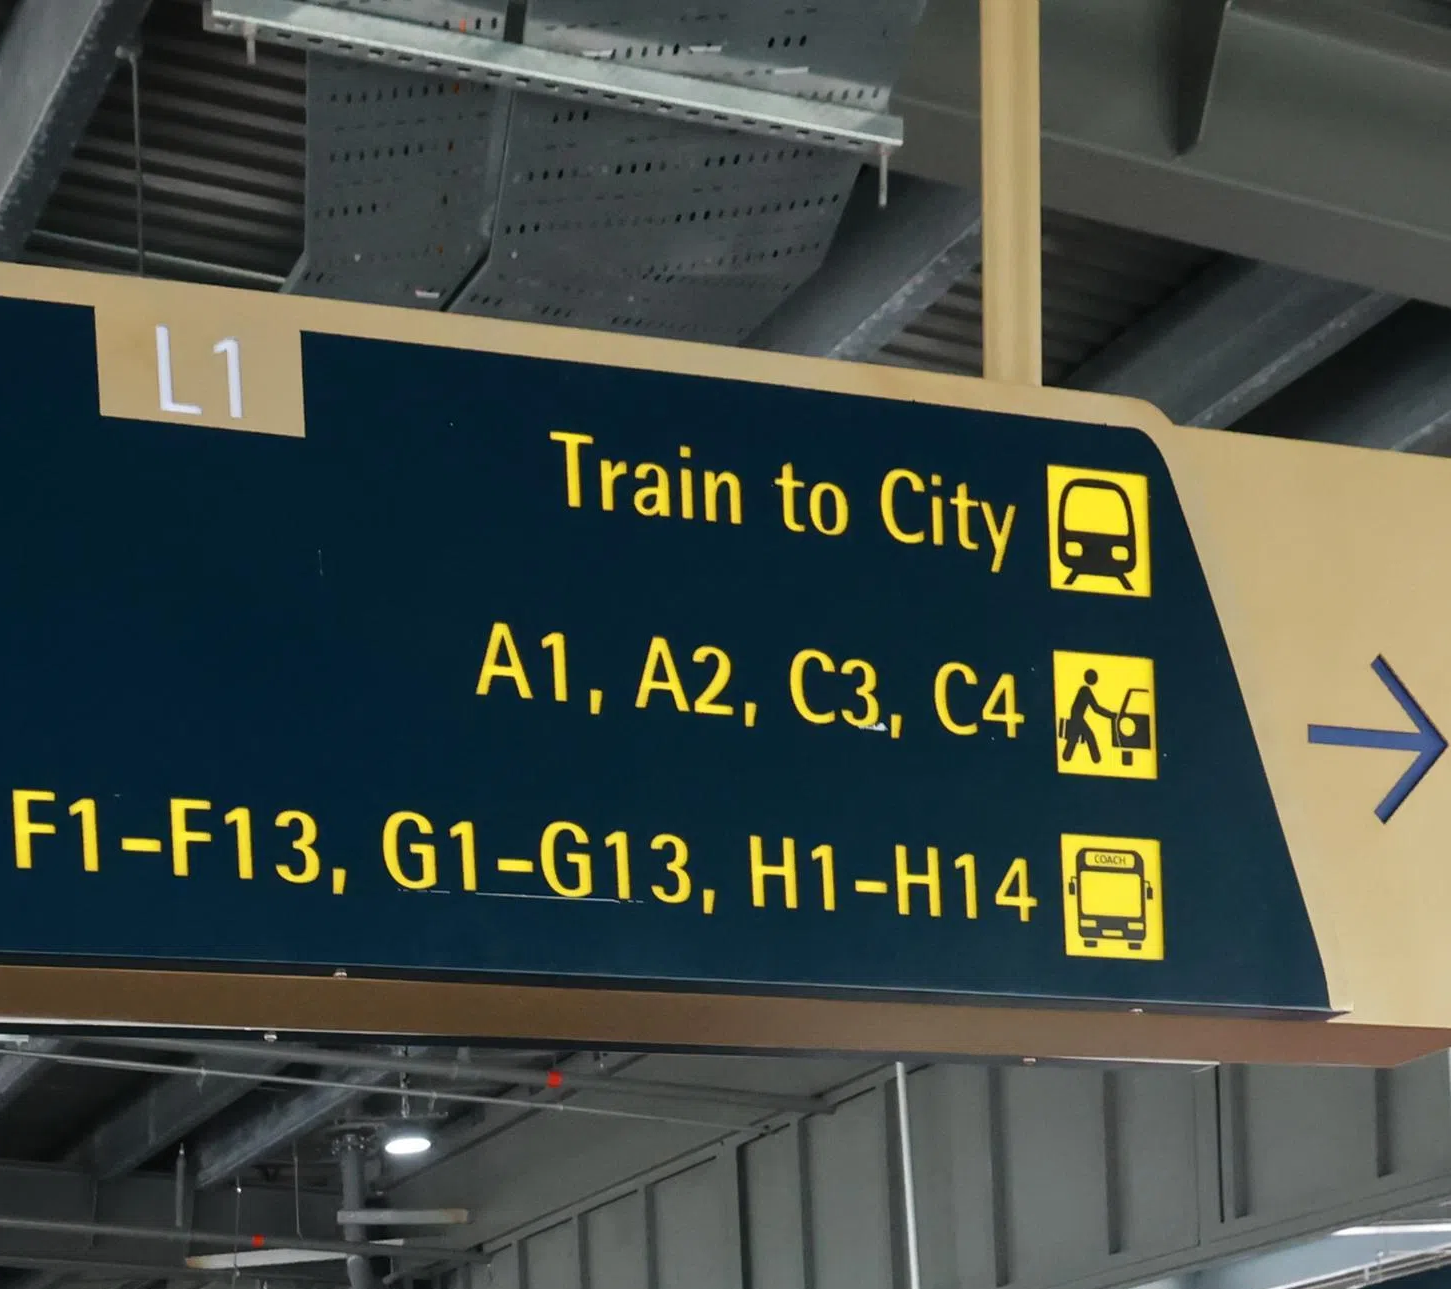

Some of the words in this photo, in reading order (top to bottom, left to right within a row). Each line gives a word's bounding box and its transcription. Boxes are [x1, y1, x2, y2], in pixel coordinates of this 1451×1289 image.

[156, 325, 242, 418] L1
[549, 431, 742, 525] Train
[774, 463, 848, 535] to
[880, 469, 1015, 572] City
[476, 622, 602, 715] A1,
[635, 637, 757, 727] A2,
[790, 649, 902, 739] C3,
[934, 662, 1024, 738] C4
[12, 789, 346, 894] F1-F13,
[382, 811, 715, 914] G1-G13,
[749, 835, 1037, 922] H1-H14
[1094, 854, 1127, 865] COACH
